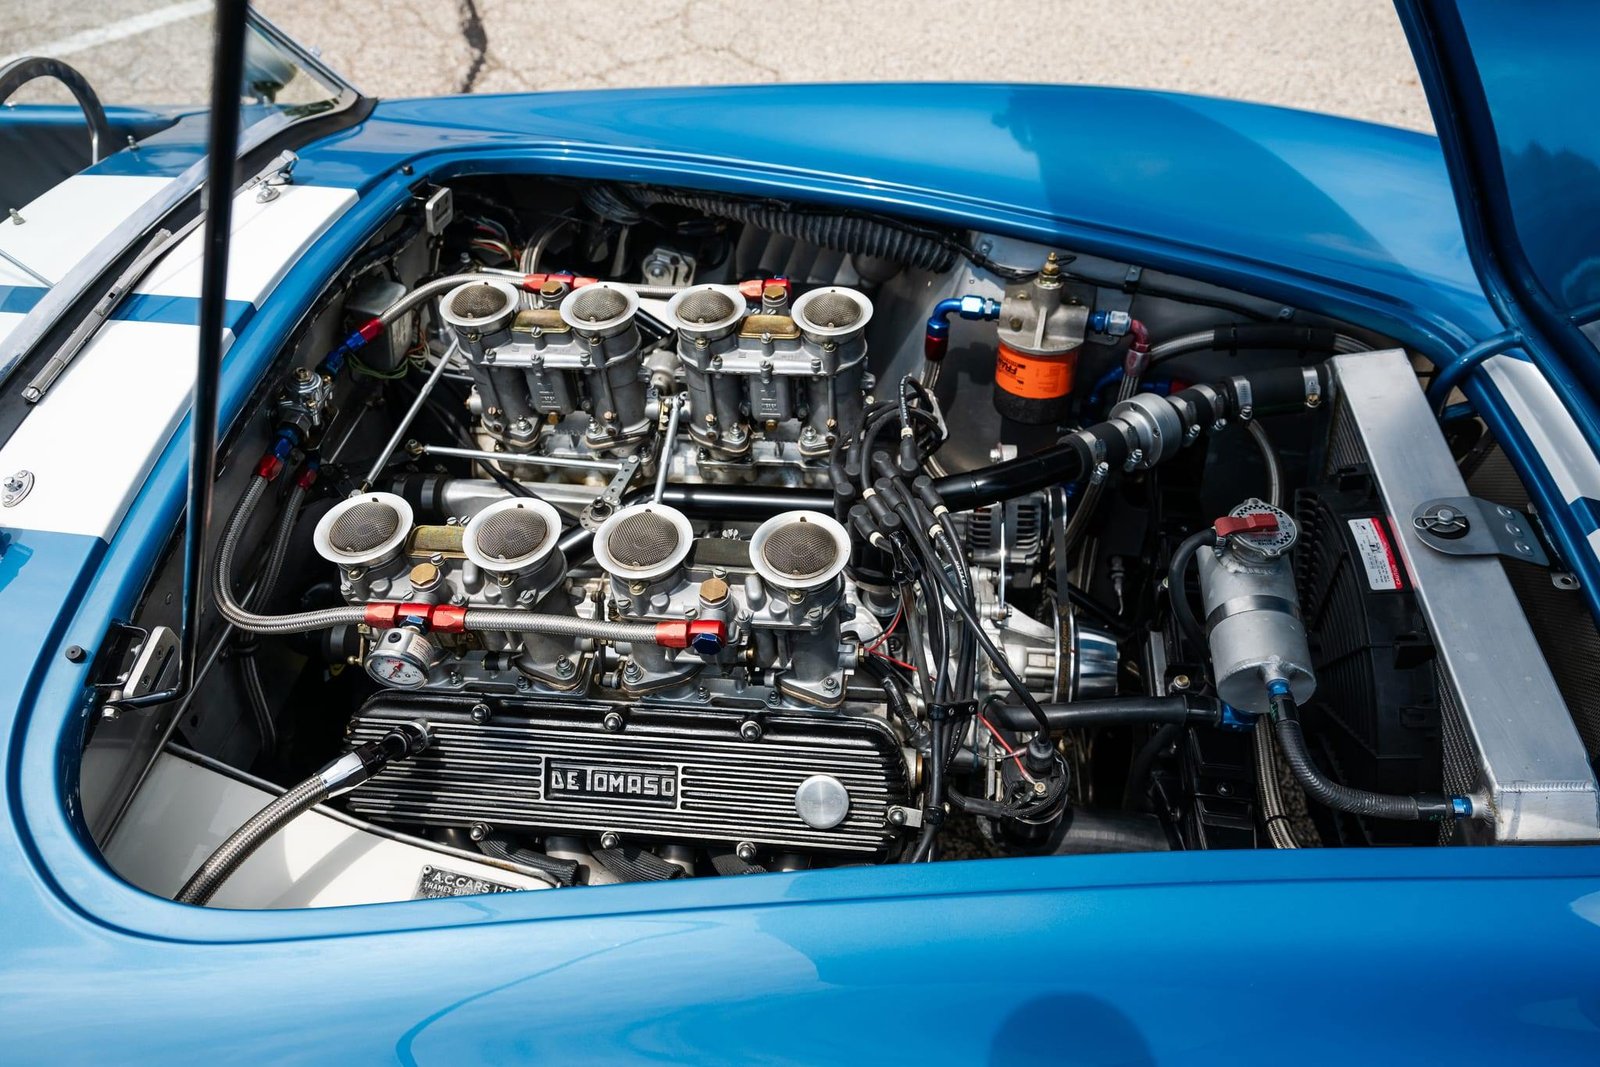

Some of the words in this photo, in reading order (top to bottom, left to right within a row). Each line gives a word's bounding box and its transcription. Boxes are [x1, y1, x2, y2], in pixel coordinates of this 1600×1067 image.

[551, 769, 580, 790] DE
[585, 766, 675, 797] TOMASO
[424, 881, 451, 893] THAMES
